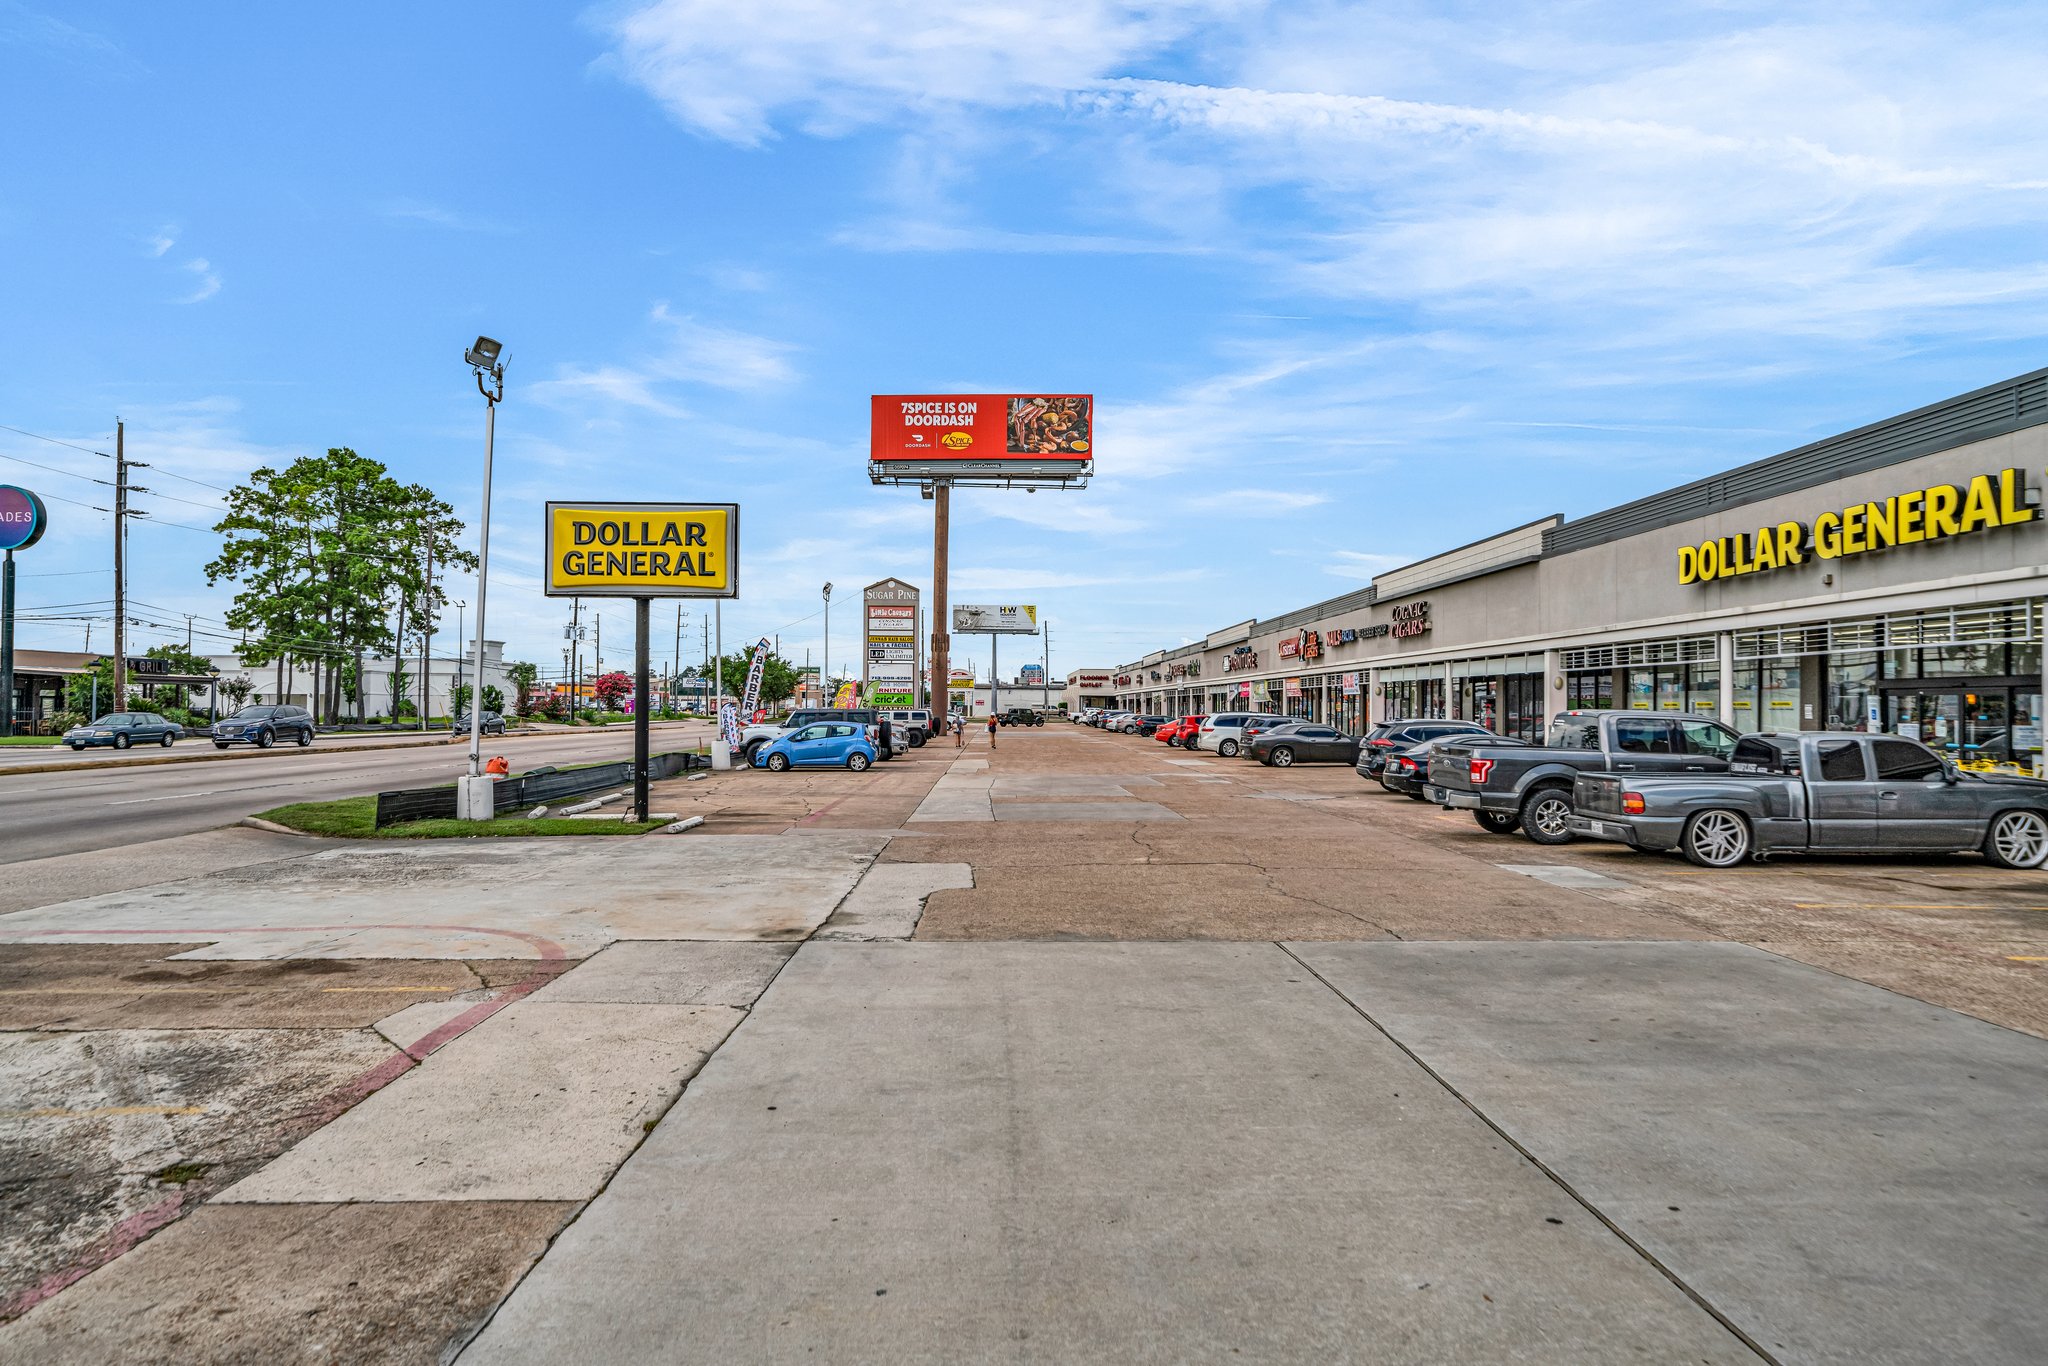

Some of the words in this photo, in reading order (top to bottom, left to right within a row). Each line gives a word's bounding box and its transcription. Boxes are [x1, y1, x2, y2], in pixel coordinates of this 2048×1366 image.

[901, 402, 942, 413] 7SPICE
[944, 402, 956, 413] IS
[957, 402, 977, 413] ON
[905, 415, 973, 426] DOORDASH
[572, 521, 707, 546] DOLLAR
[1678, 521, 1804, 585] DOLLAR
[1814, 468, 2033, 560] GENERAL
[563, 550, 716, 577] GENERAL
[866, 589, 894, 600] SUGAR
[897, 589, 917, 600] PINE
[1391, 601, 1426, 621] COGNAC
[1325, 629, 1342, 646] NAILS
[1389, 619, 1424, 639] CIGARS
[139, 661, 167, 672] GRILL
[744, 655, 764, 711] BARBER
[874, 695, 907, 704] cricket
